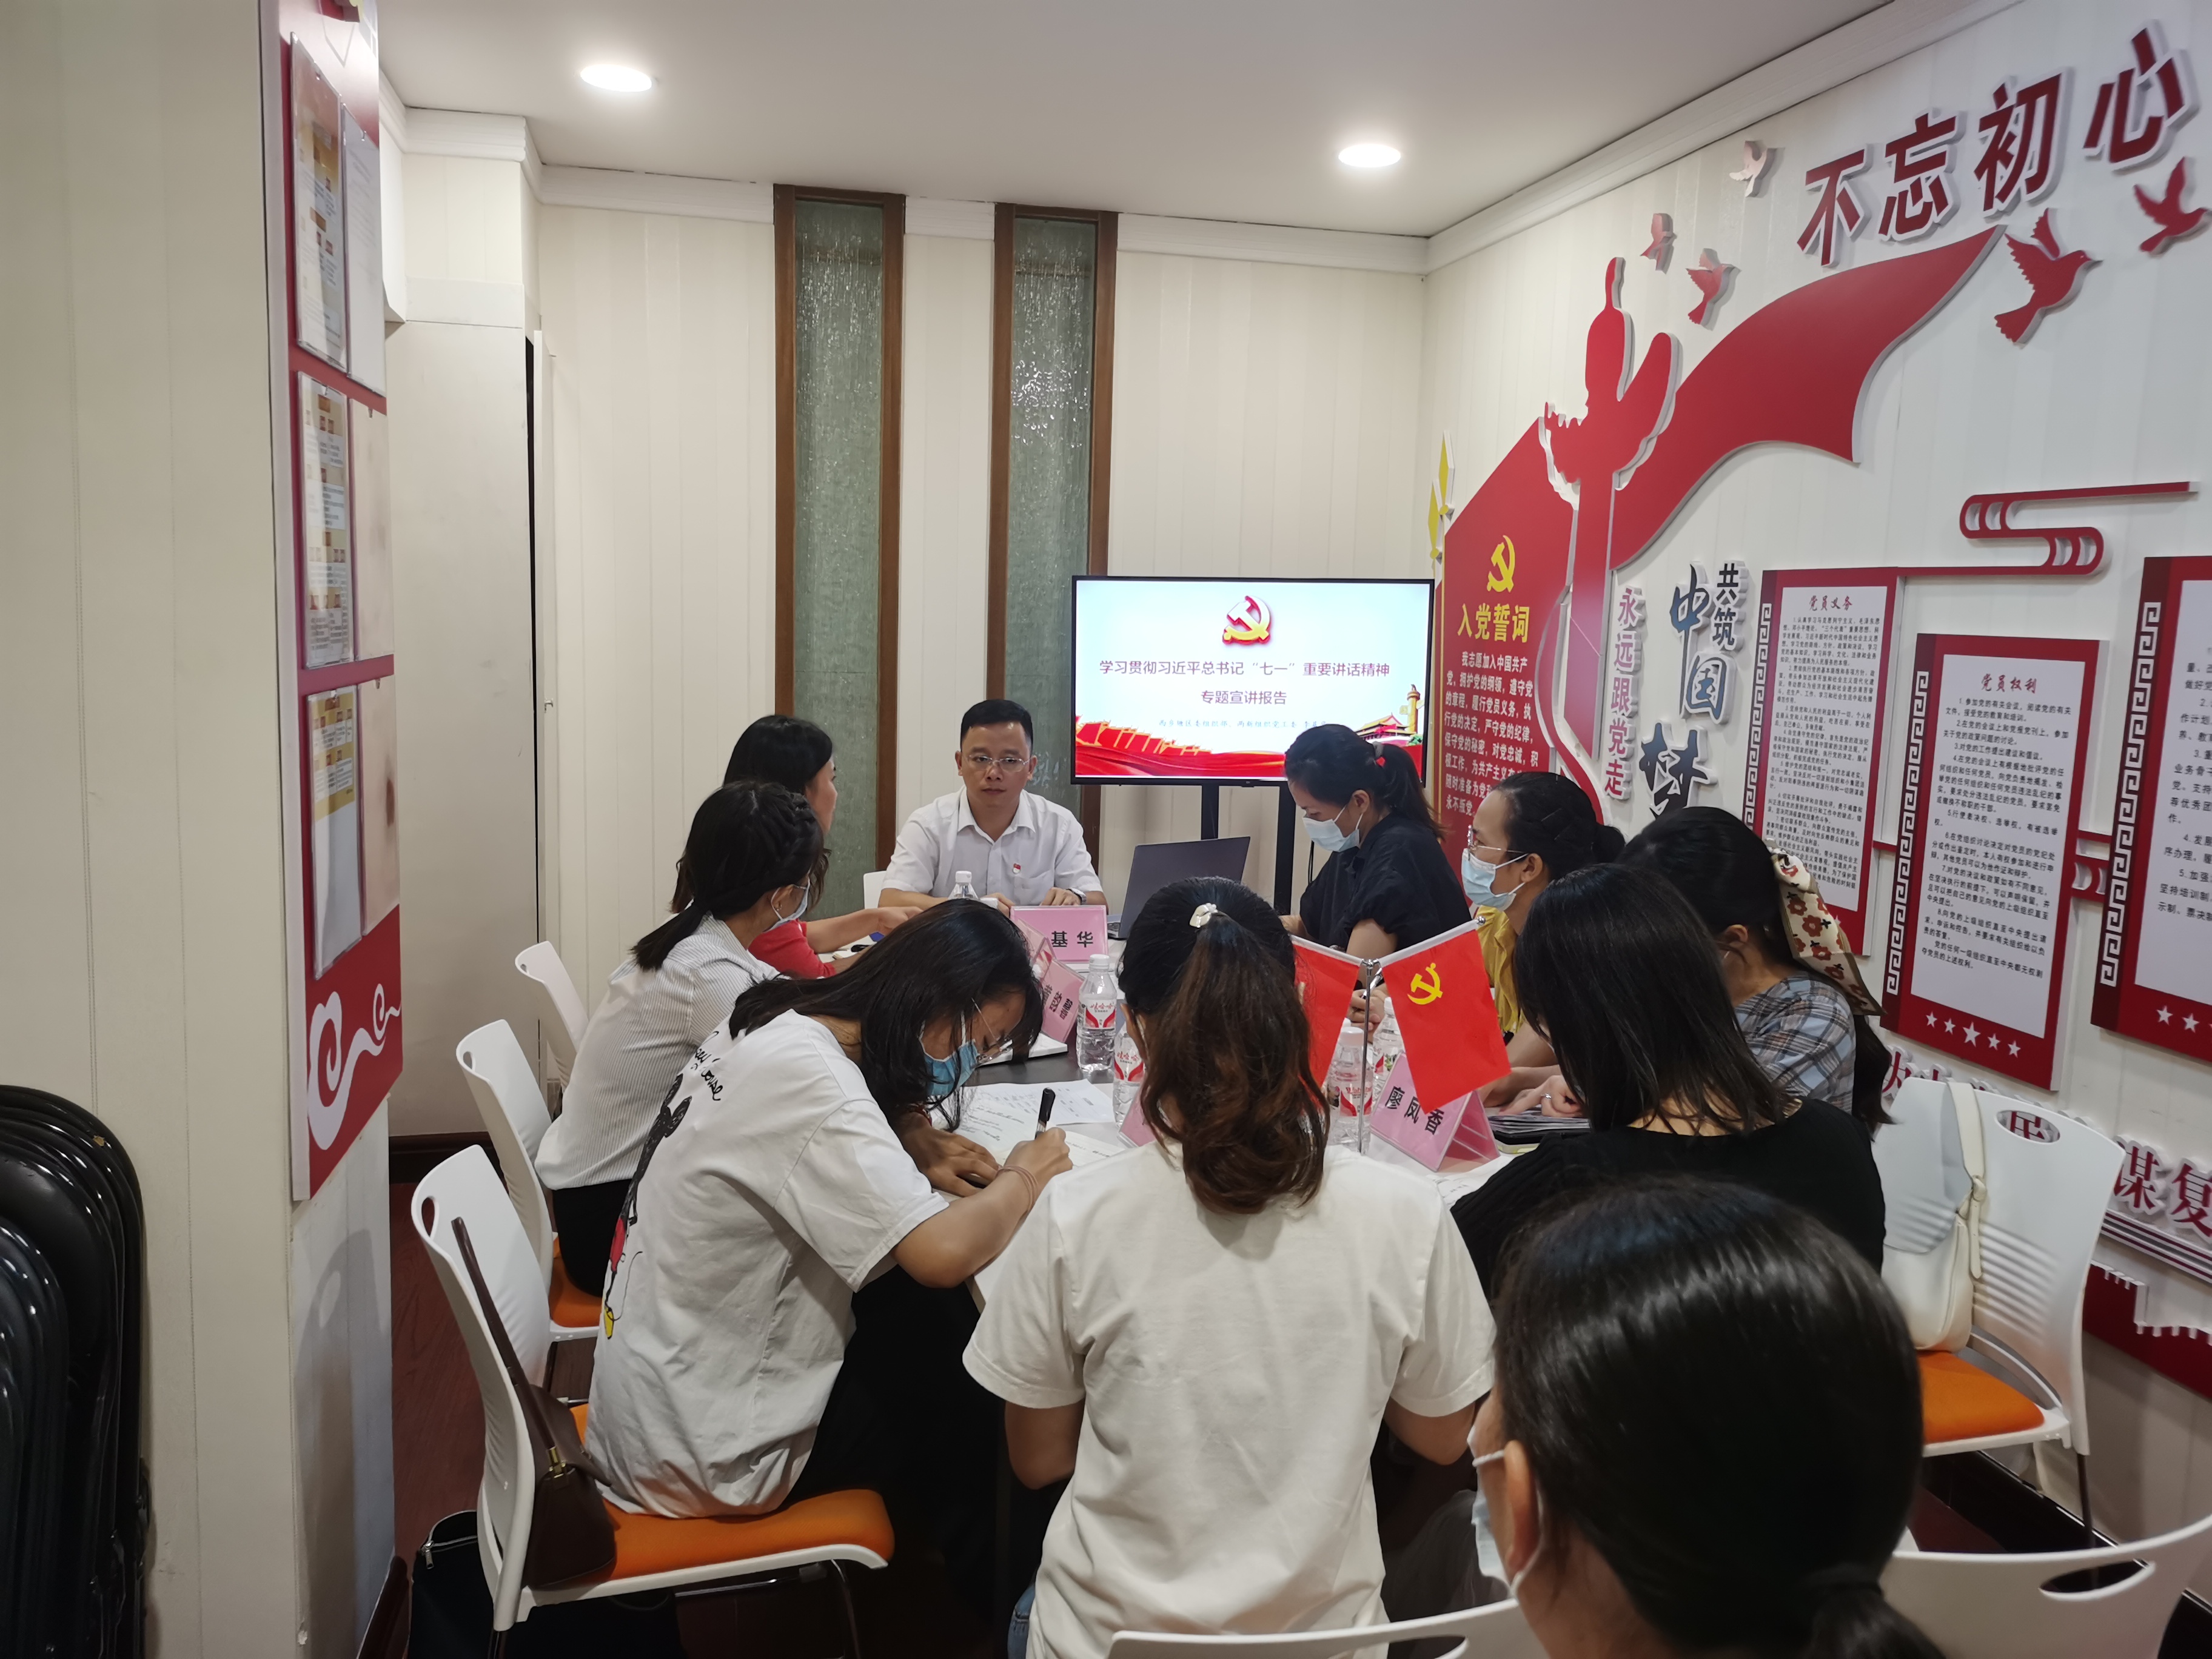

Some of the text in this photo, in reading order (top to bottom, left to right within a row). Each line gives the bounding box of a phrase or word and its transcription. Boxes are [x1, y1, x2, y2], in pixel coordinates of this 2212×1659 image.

[1797, 28, 2185, 266] 不忘初心
[1713, 563, 1739, 647] 共筑
[1809, 595, 1852, 611] 党员义务
[1457, 603, 1530, 643] 入党誓词
[1462, 651, 1527, 673] 我志愿加入中国共产
[1201, 690, 1287, 705] 专题宣讲报告
[1604, 588, 1640, 797] 永远跟党走
[1982, 674, 2037, 693] 党员权利
